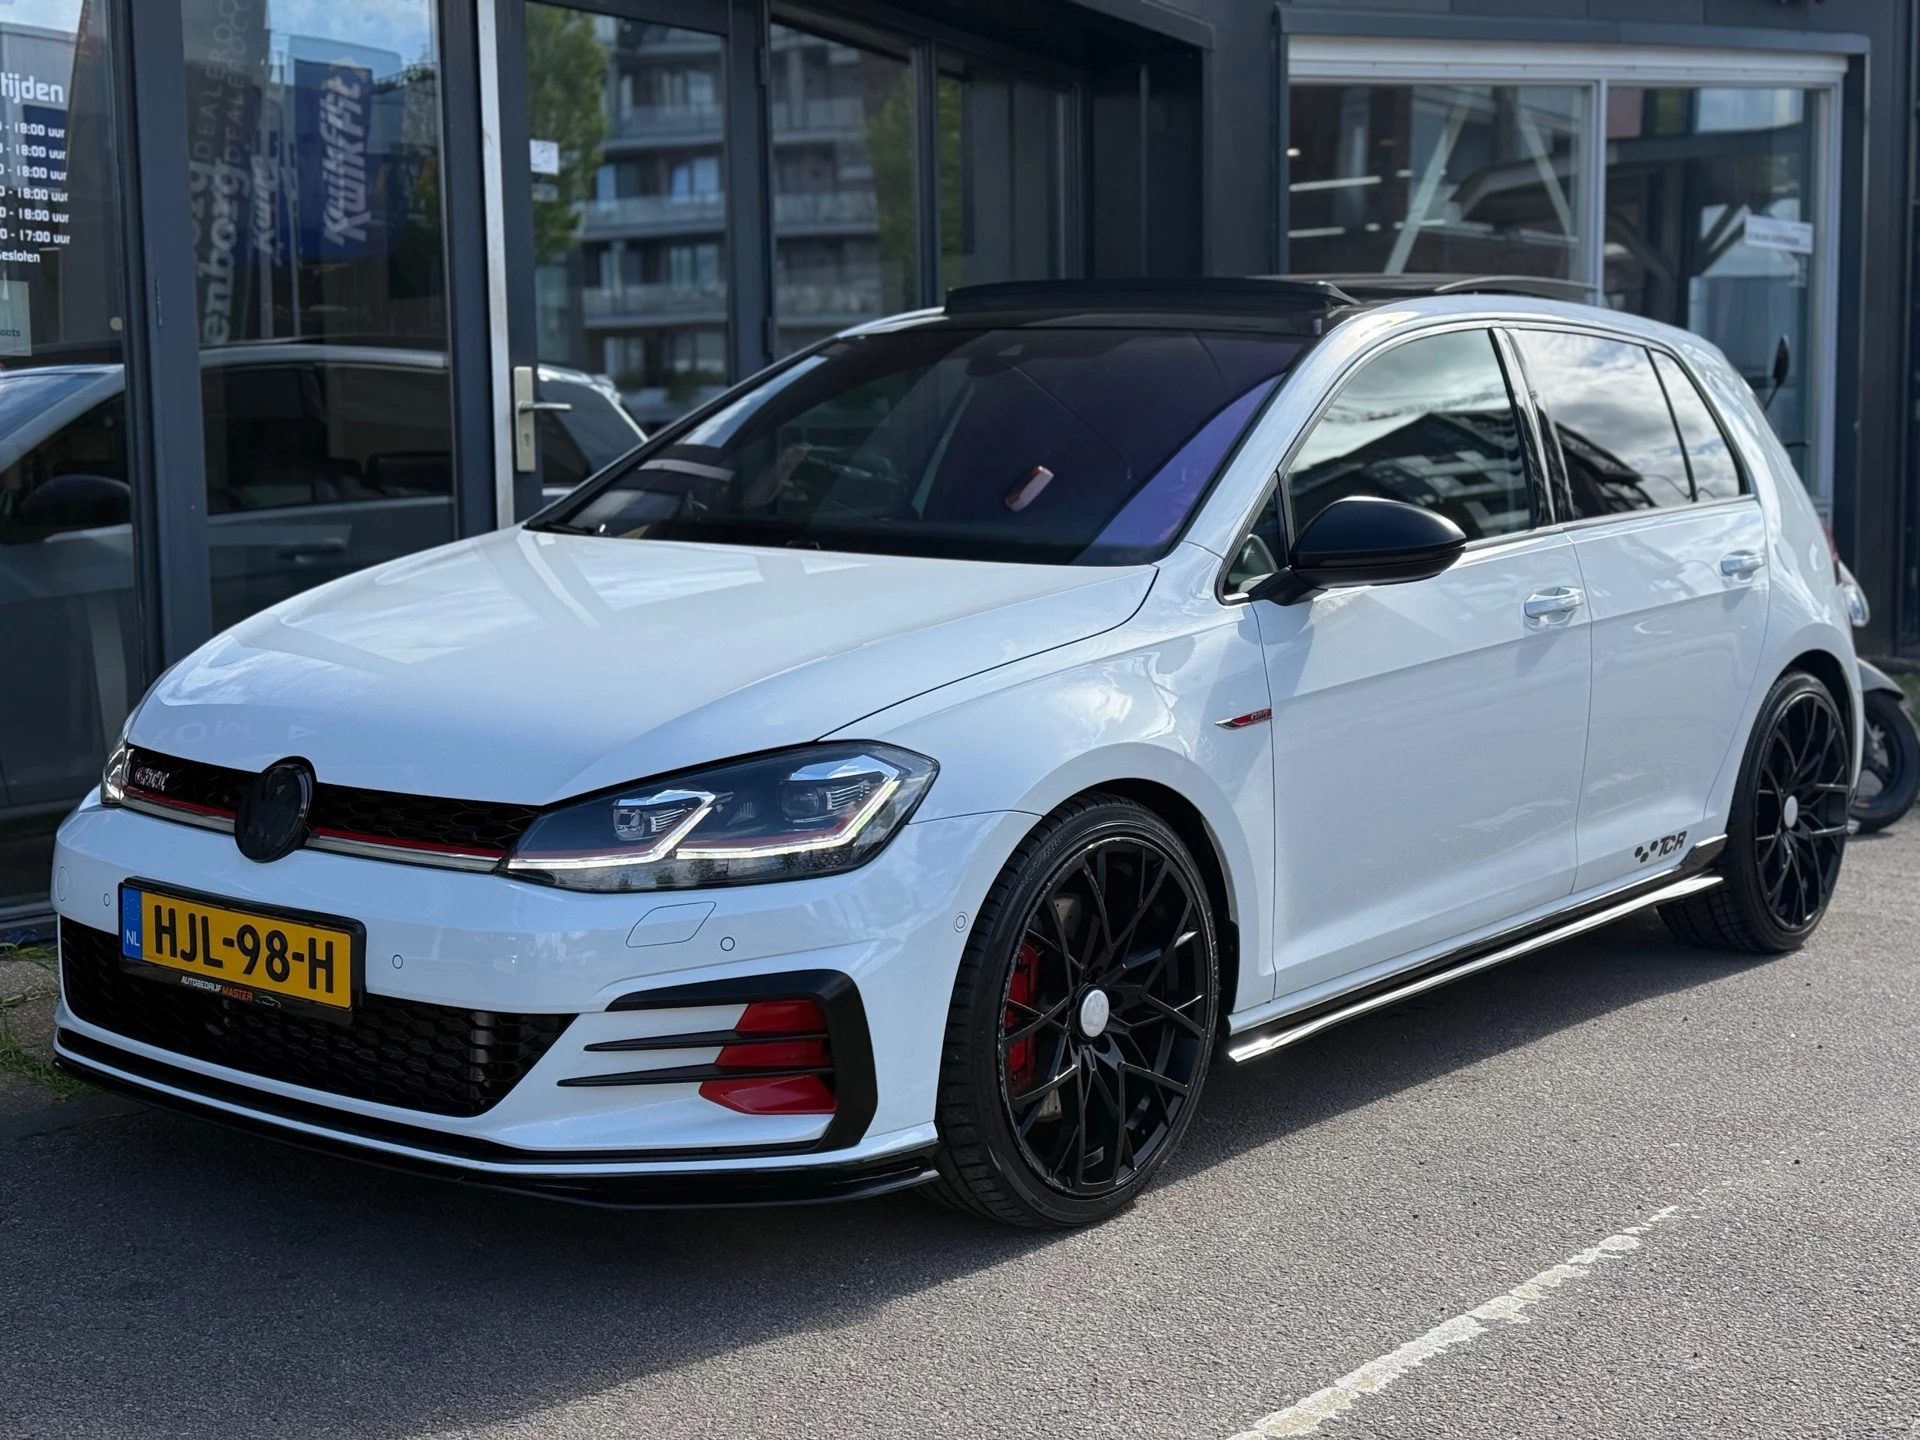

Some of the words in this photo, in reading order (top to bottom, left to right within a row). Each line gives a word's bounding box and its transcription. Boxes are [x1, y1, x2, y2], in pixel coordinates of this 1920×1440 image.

[0, 72, 64, 104] tijden
[15, 122, 45, 136] 18:00
[48, 128, 65, 138] uur
[16, 144, 46, 158] 18:00
[49, 149, 66, 160] uur
[17, 165, 47, 179] 18:00
[50, 170, 67, 181] uur
[18, 187, 48, 200] 18:00
[51, 192, 68, 202] uur
[19, 208, 49, 222] 18:00
[52, 213, 69, 223] uur
[20, 229, 51, 243] 17:00
[53, 234, 70, 244] uur
[0, 249, 41, 263] esloten
[126, 929, 140, 947] NL
[154, 904, 334, 994] HJL-98-H
[181, 975, 222, 993] AUTOBEDRIJF
[222, 986, 253, 1002] MASTER
